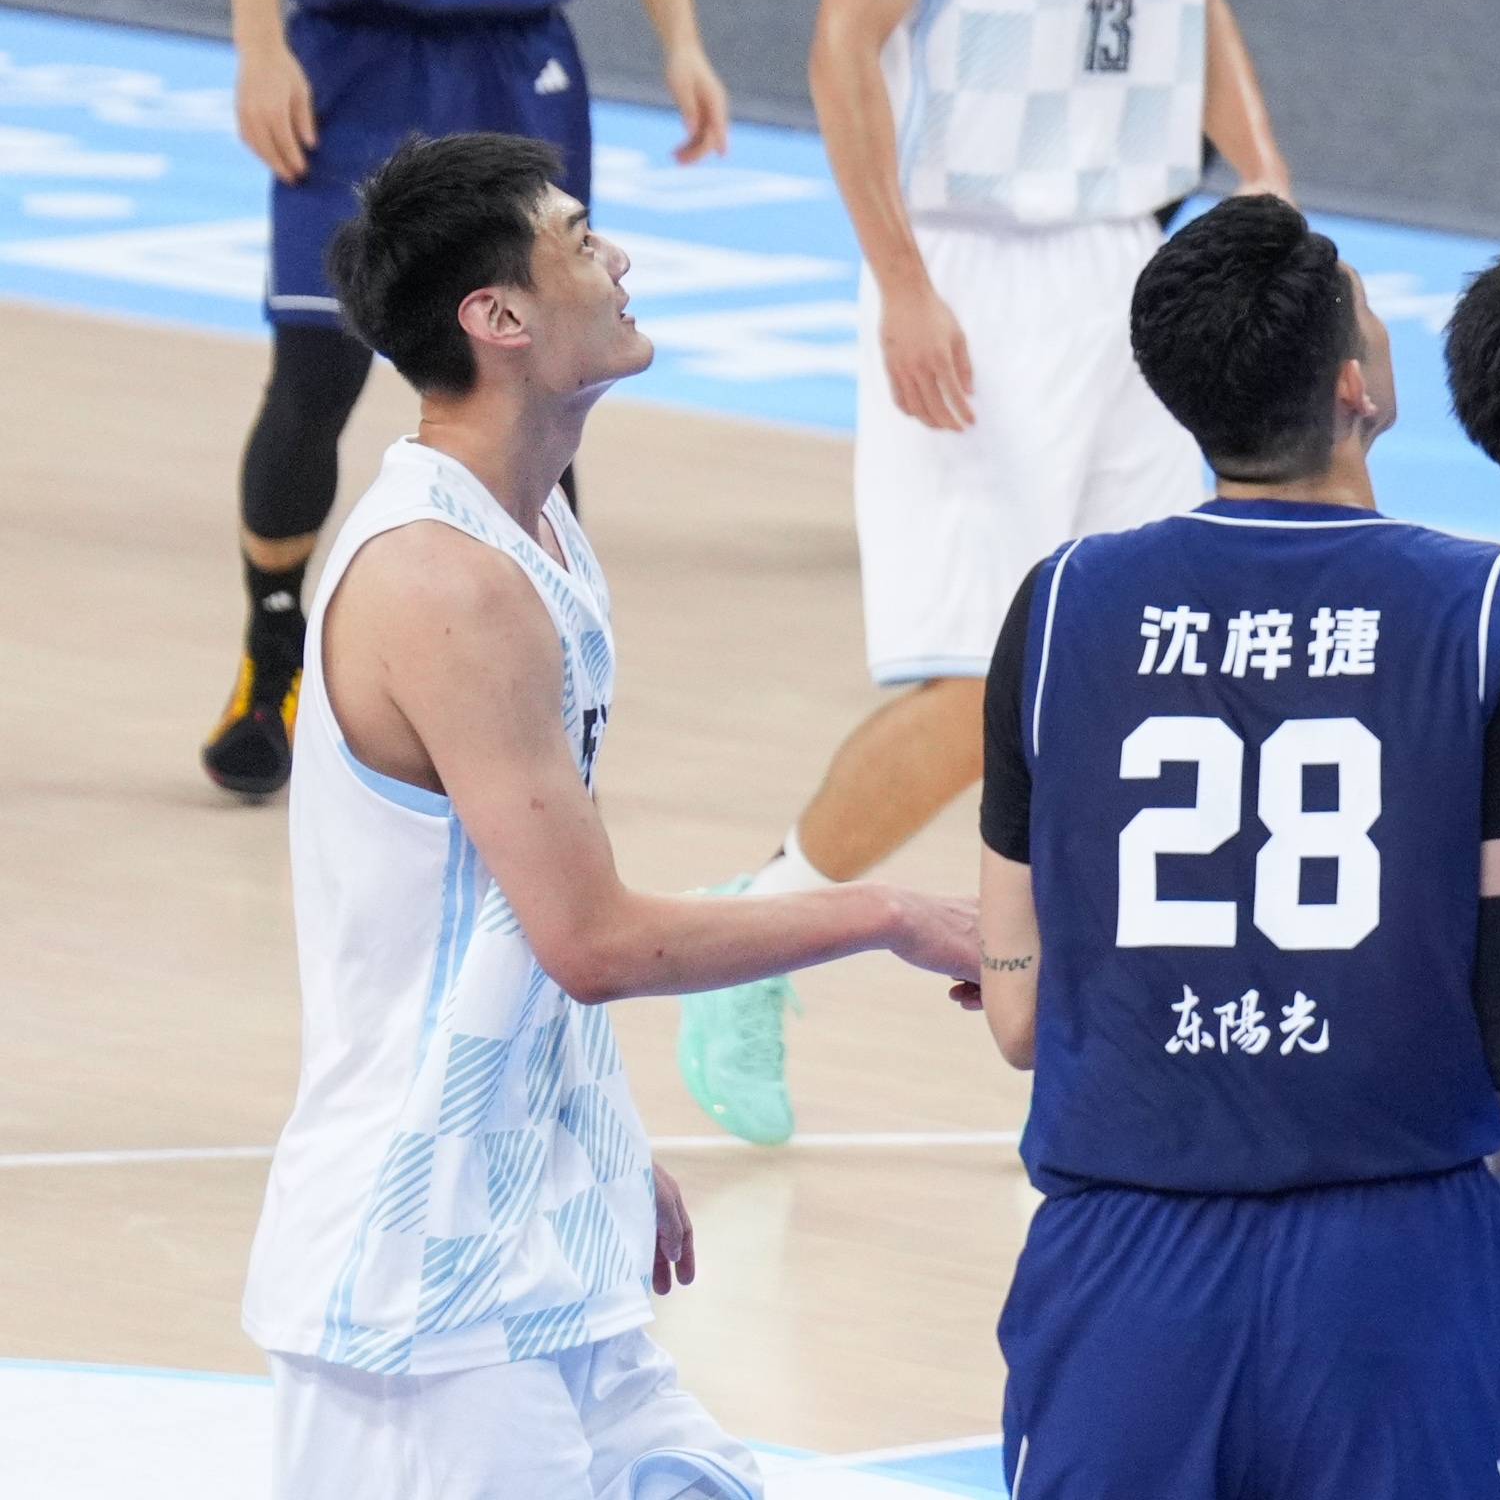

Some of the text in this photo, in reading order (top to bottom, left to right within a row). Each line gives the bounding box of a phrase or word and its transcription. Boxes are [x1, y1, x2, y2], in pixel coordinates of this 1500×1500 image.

[1136, 604, 1383, 682] 沈梓捷
[1115, 714, 1384, 952] 28
